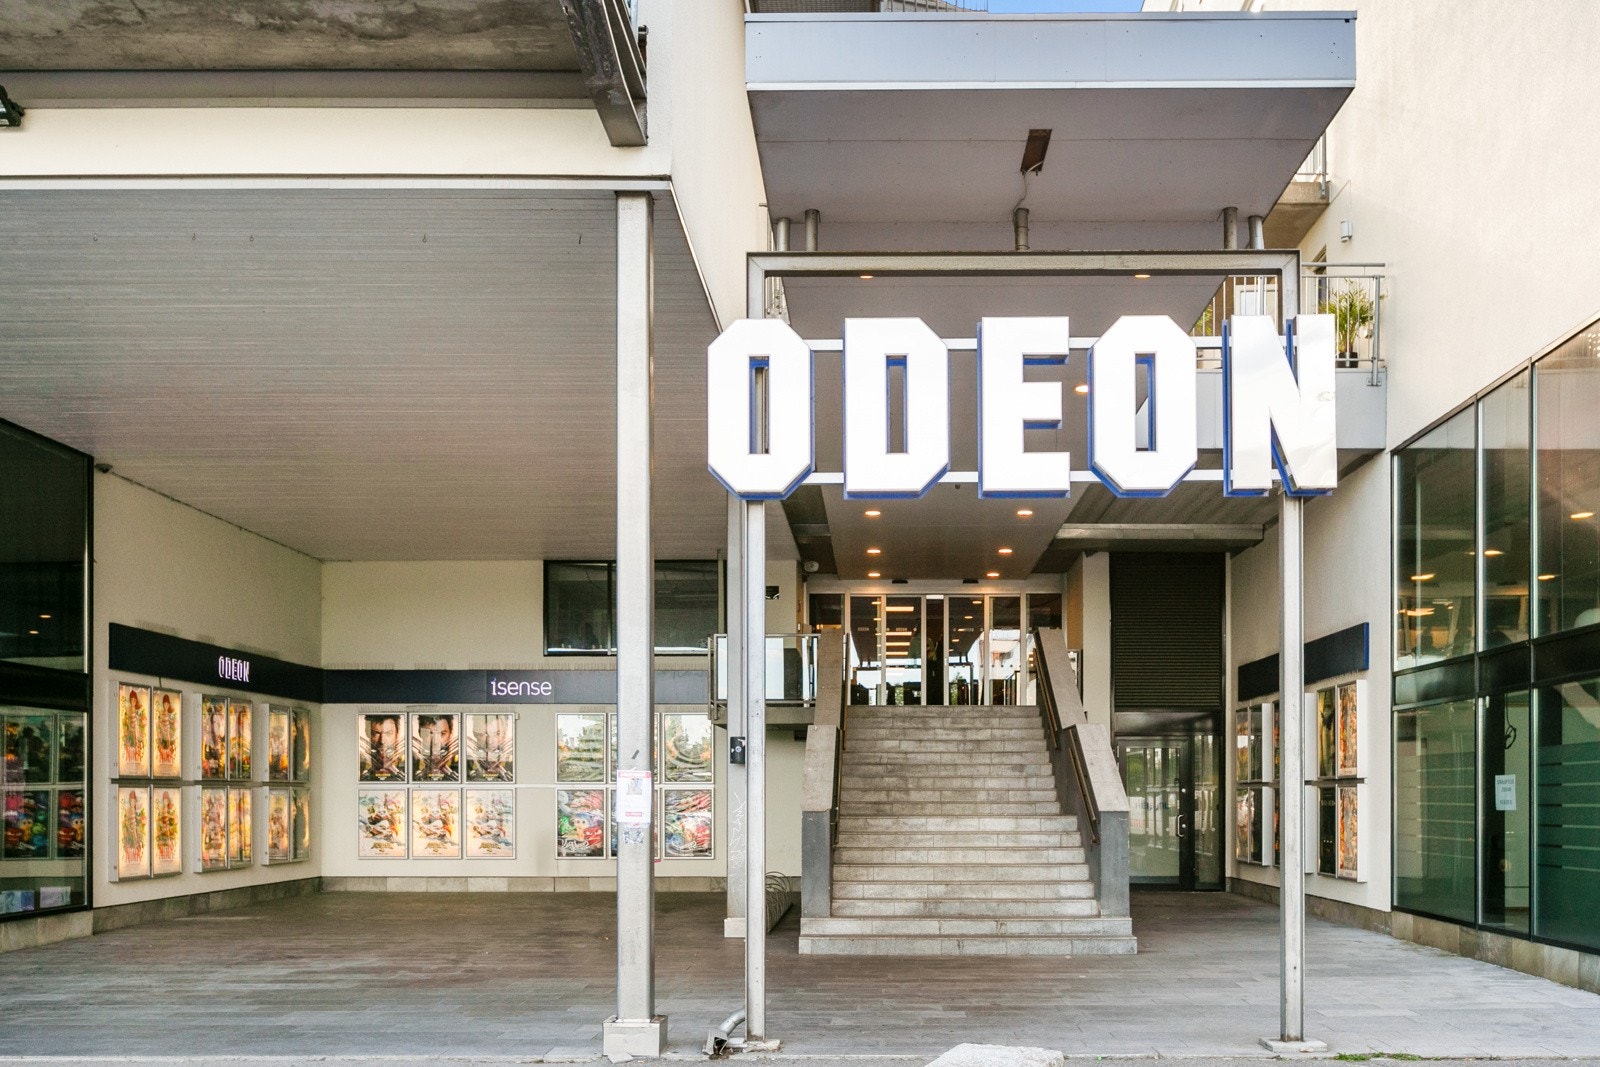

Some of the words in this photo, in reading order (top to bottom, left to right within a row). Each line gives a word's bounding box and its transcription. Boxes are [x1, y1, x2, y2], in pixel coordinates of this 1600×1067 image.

[708, 315, 1337, 498] ODEON
[218, 655, 250, 683] ODEON
[490, 677, 553, 696] isense
